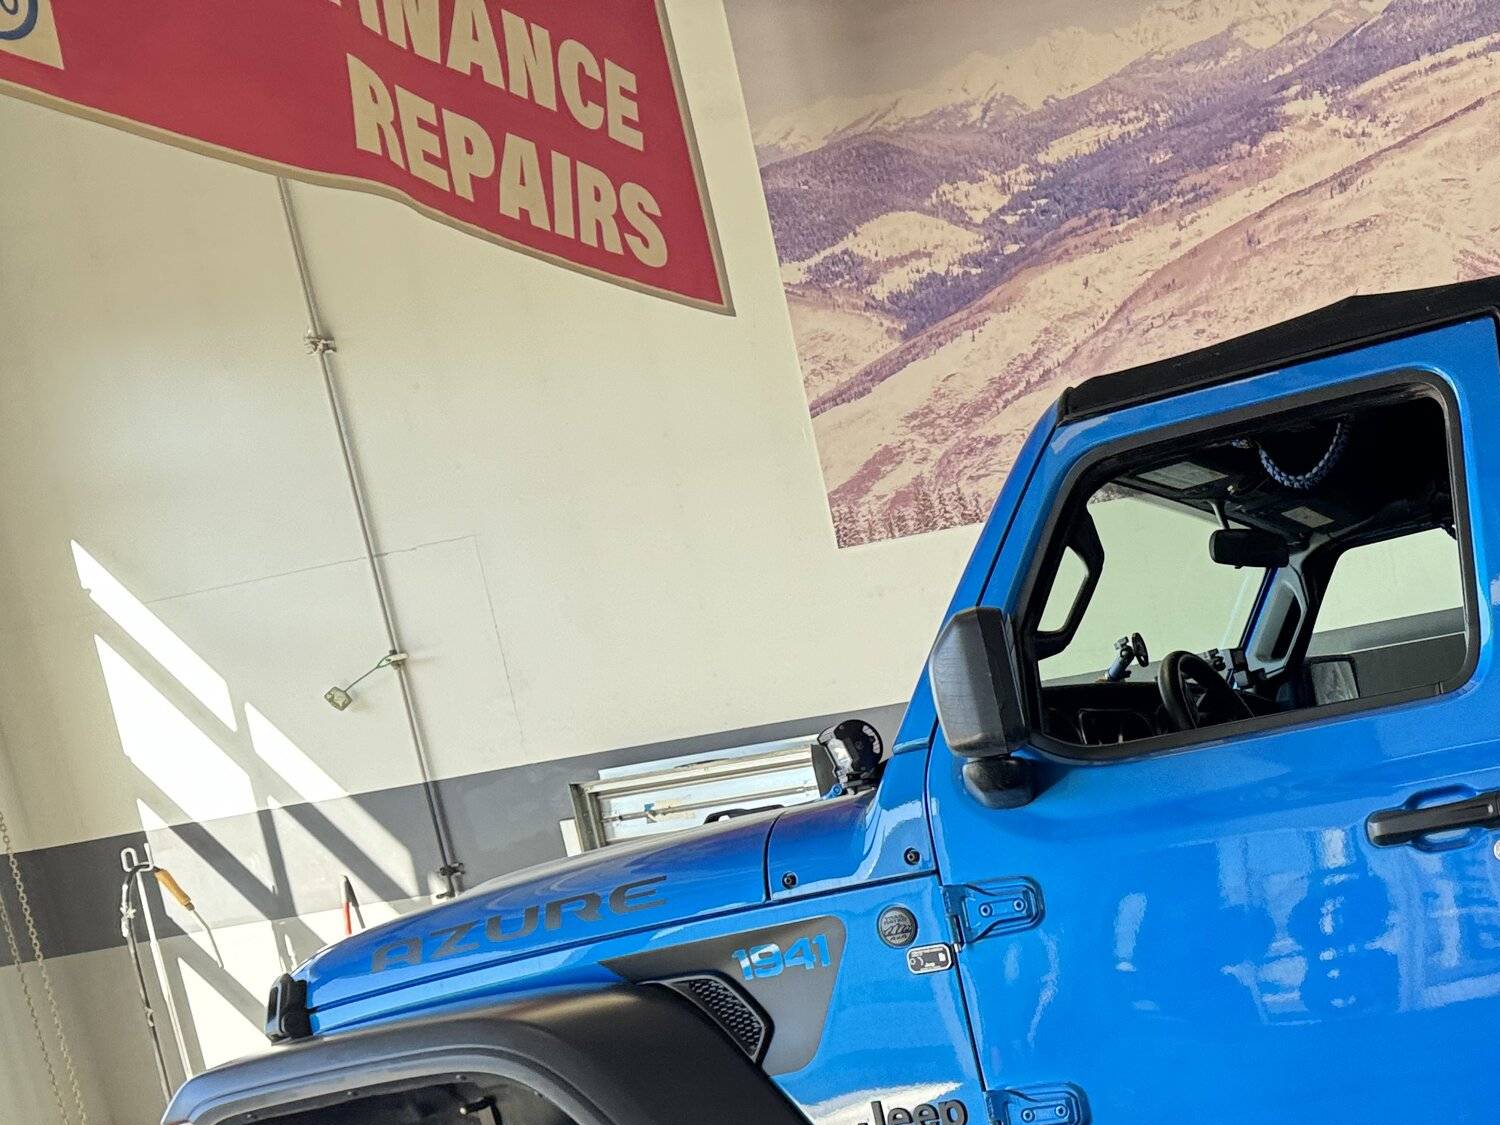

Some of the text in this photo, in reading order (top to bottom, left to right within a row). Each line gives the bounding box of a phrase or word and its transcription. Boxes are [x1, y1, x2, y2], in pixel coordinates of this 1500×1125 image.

[328, 0, 645, 152] NANCE
[345, 52, 669, 268] REPAIRS
[371, 875, 668, 974] AZURE
[730, 934, 832, 982] 1941
